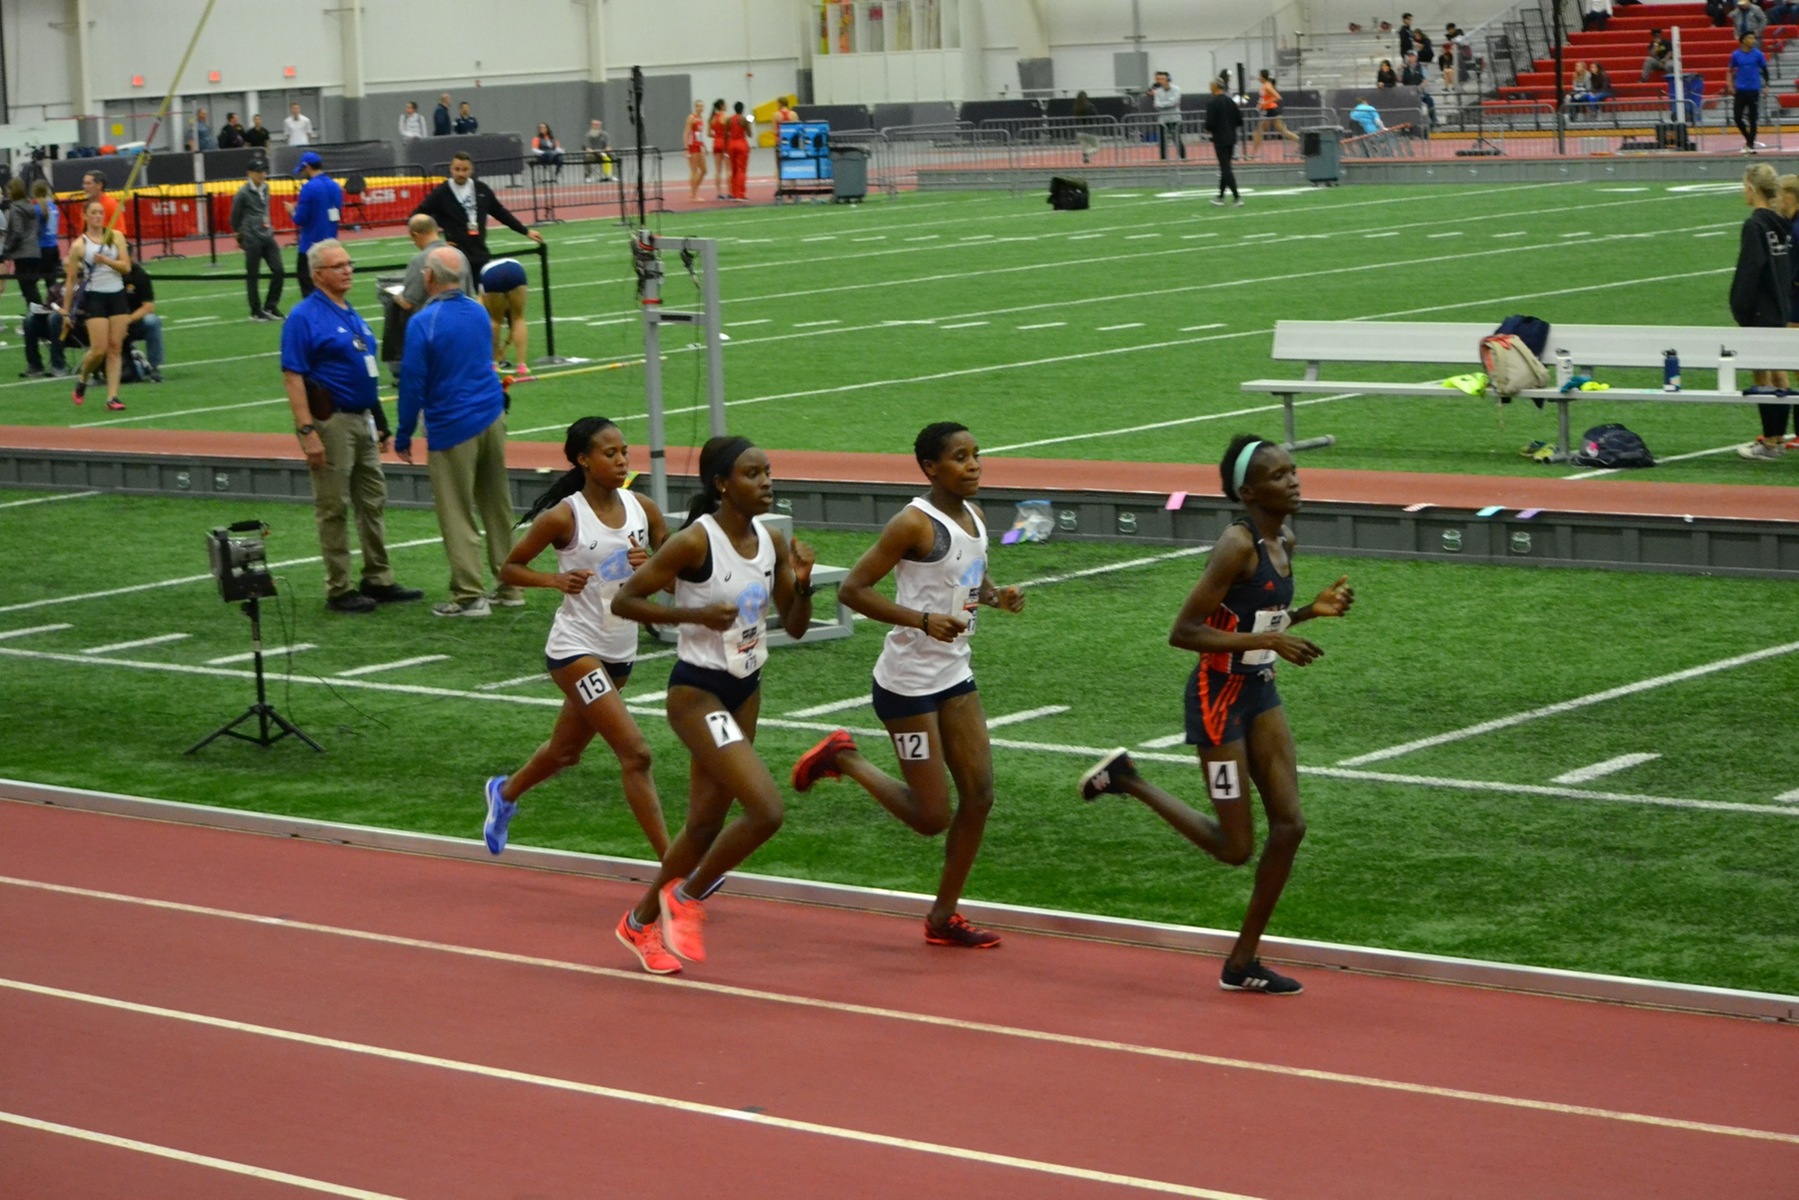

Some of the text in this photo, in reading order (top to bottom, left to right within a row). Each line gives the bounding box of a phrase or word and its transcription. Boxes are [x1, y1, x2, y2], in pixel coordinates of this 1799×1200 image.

[579, 671, 606, 700] 15
[710, 714, 730, 742] 7
[898, 734, 923, 758] 12
[1215, 764, 1232, 796] 4
